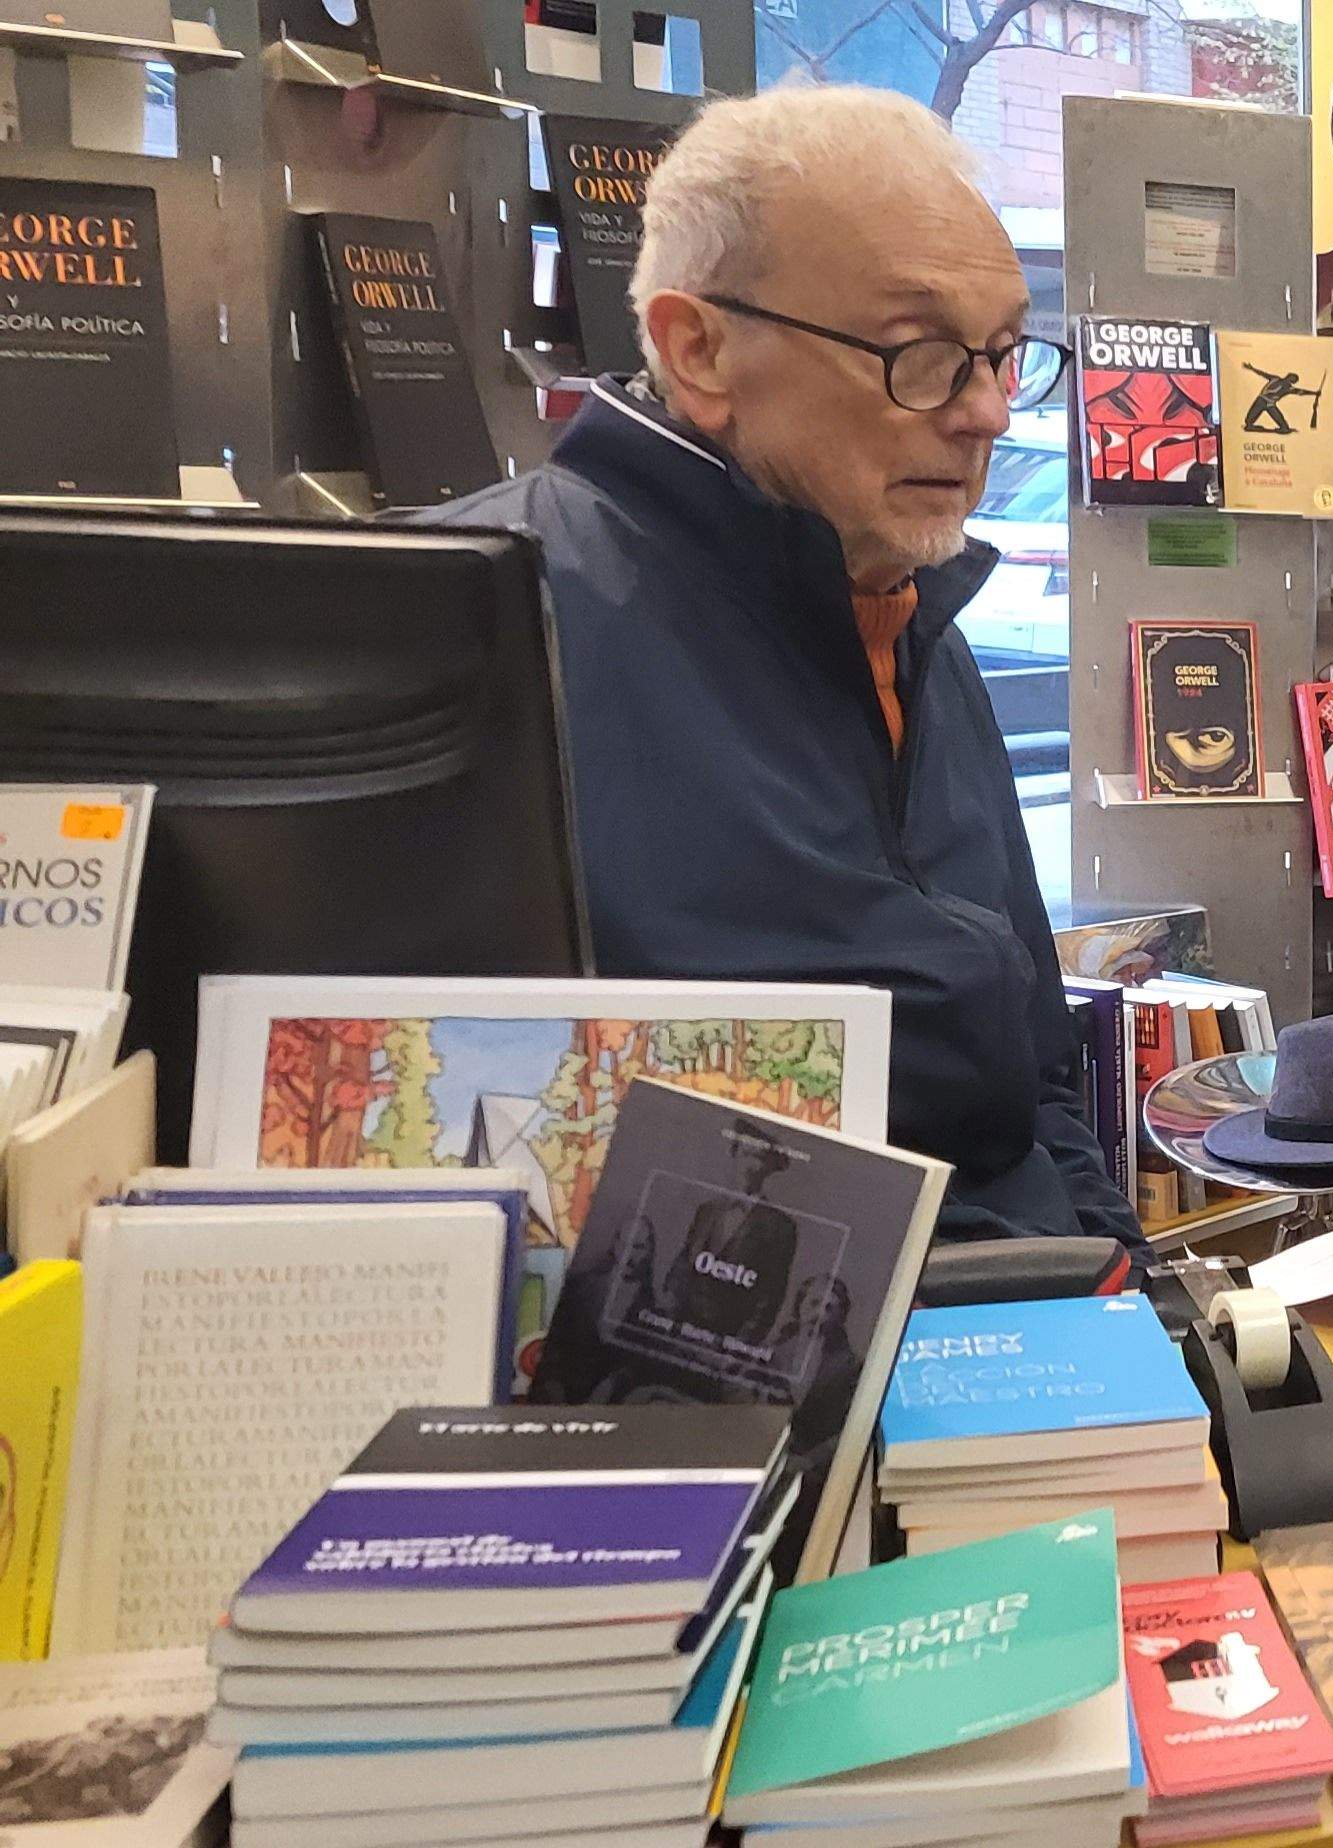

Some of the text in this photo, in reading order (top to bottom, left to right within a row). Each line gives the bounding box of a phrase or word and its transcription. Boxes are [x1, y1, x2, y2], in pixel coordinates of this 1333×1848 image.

[569, 143, 660, 176] GEOR
[344, 244, 436, 278] GEORGE
[352, 279, 446, 312] ORWELL
[1099, 323, 1193, 346] GEORGE
[1089, 342, 1207, 370] ORWELL
[1244, 443, 1285, 452] GEORGE
[1244, 453, 1287, 463] ORWELL
[1175, 665, 1217, 676] GEORGE
[1175, 676, 1219, 686] ORWELL
